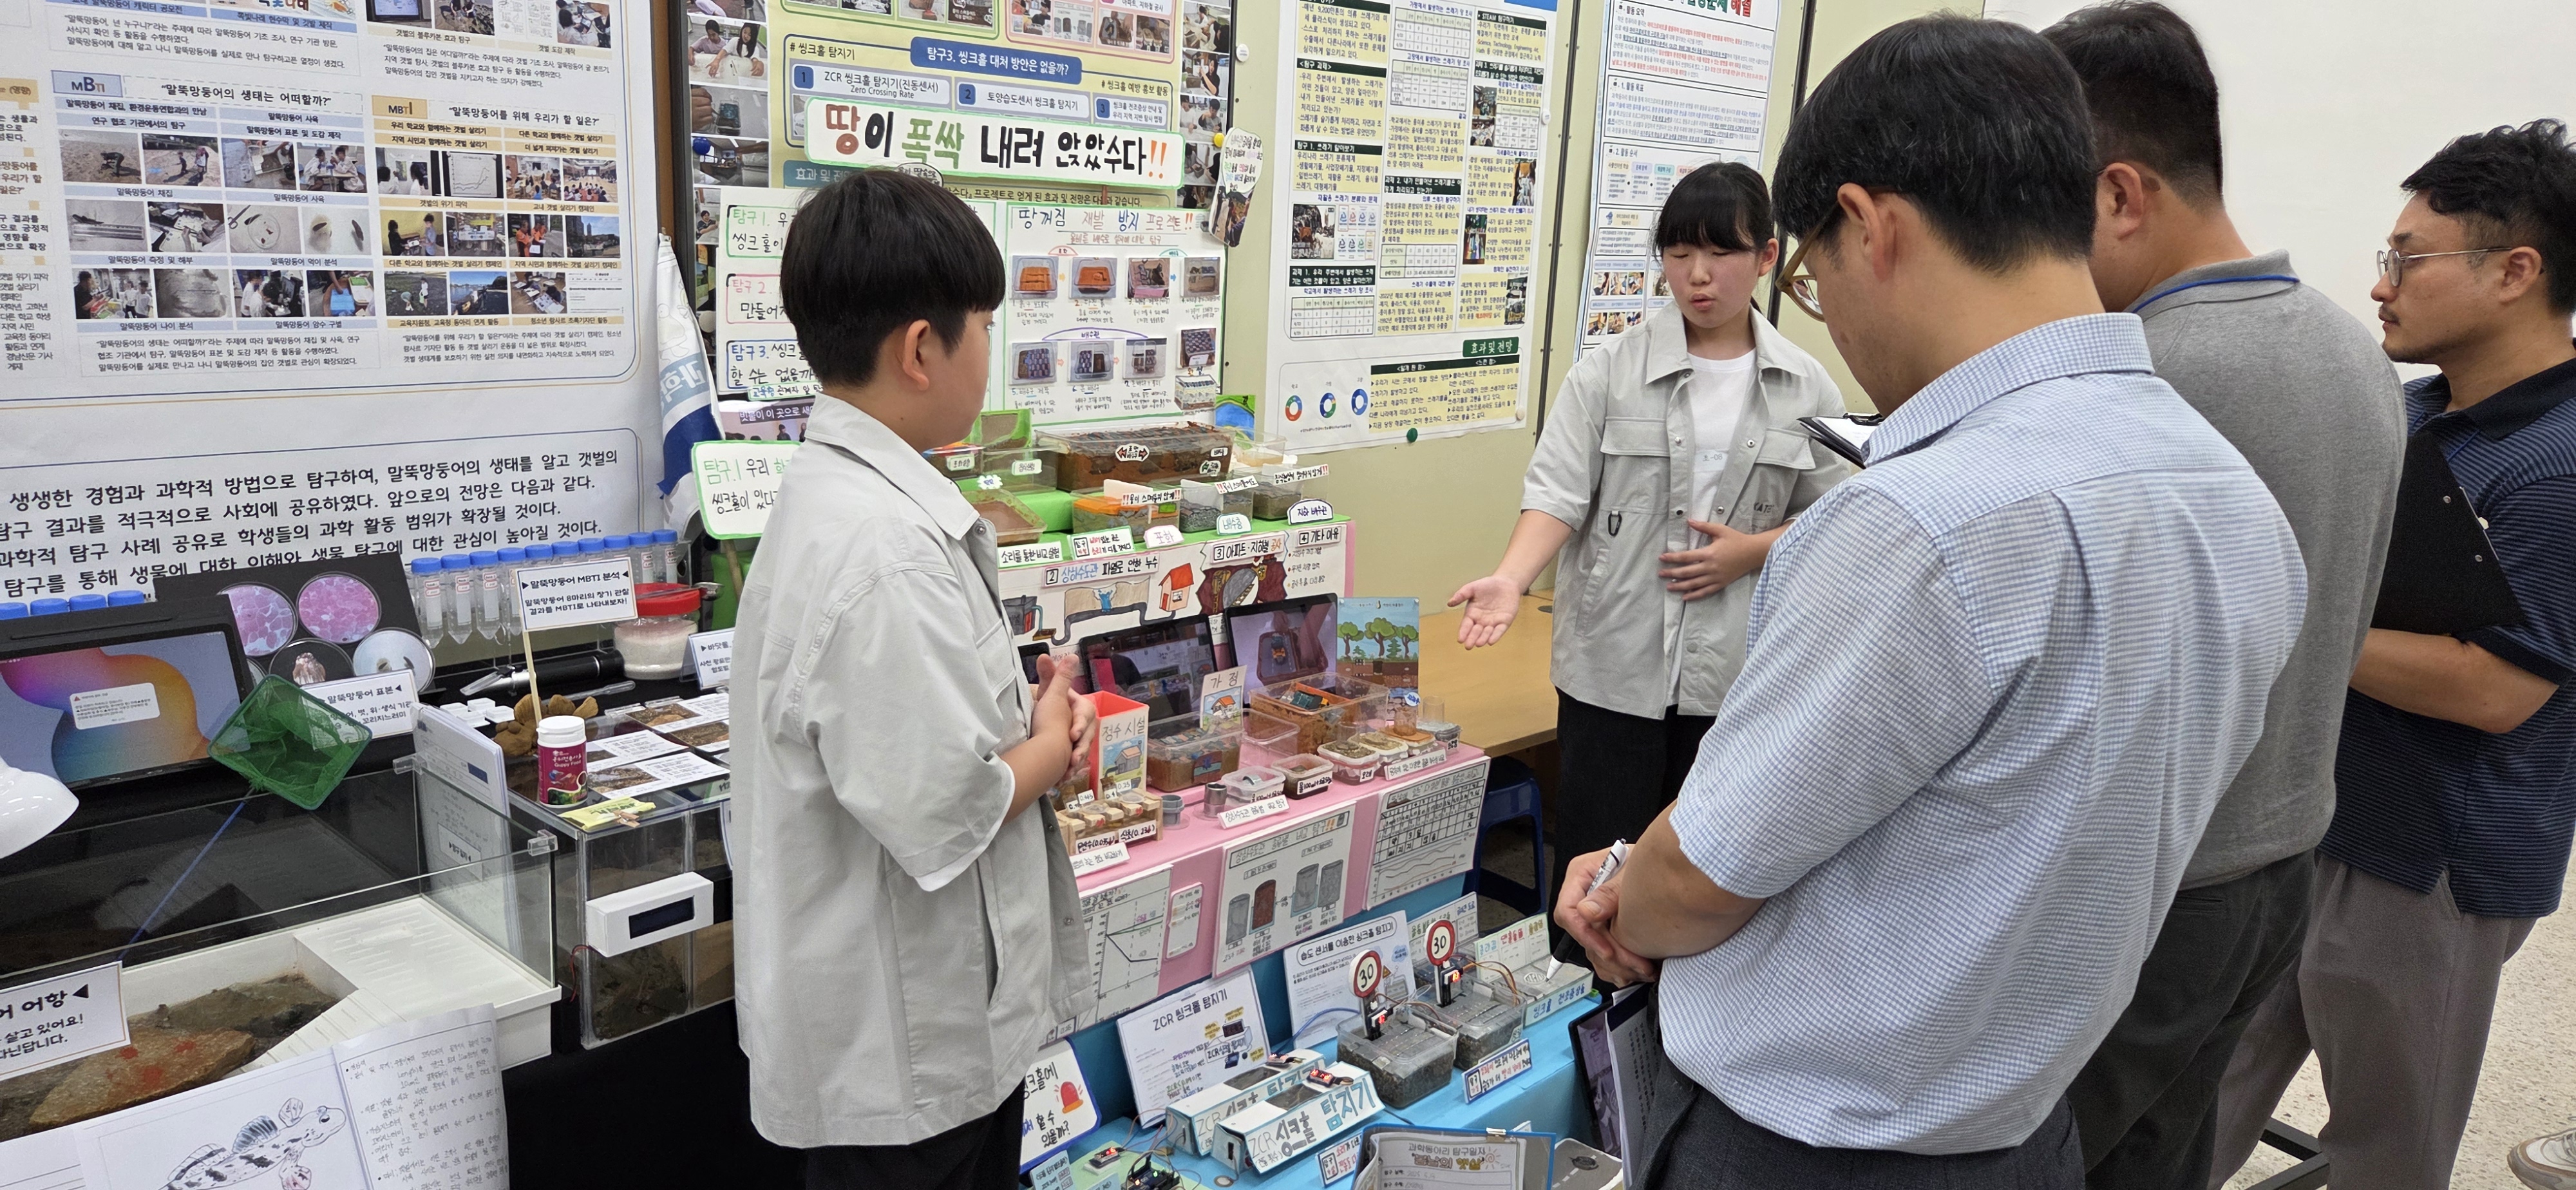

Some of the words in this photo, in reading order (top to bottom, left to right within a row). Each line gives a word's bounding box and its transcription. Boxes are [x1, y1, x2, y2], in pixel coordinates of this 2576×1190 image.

[790, 42, 795, 52] #
[799, 42, 826, 57] 씽크홀
[829, 46, 855, 61] 탐지기
[927, 46, 956, 62] 탐구3.
[958, 50, 987, 67] 씽크홀
[990, 55, 1009, 69] 대처
[1011, 59, 1037, 72] 방안은
[1040, 61, 1069, 75] 없을까?
[71, 77, 105, 93] MBTI
[801, 71, 806, 82] 1
[824, 71, 842, 82] ZCR
[844, 73, 870, 85] 씽크홀
[873, 76, 939, 93] 탐지기(진동센서)
[241, 90, 274, 102] 생태는
[851, 85, 867, 93] Zero
[868, 87, 897, 98] Crossing
[965, 89, 971, 99] 2
[1107, 80, 1126, 91] 씽크홀
[1128, 84, 1141, 93] 예방
[388, 101, 413, 115] MBTI
[987, 92, 1032, 107] 토양습도센서
[1035, 97, 1056, 109] 씽크홀
[1058, 100, 1078, 111] 탐지기
[1100, 104, 1106, 113] 3
[512, 110, 530, 122] 위해
[534, 113, 559, 124] 우리가
[564, 115, 571, 124] 할
[826, 104, 894, 157] 땅이
[902, 118, 965, 169] 폭싹
[981, 125, 1044, 169] 내려
[1056, 131, 1167, 179] 앉았수다!!
[974, 188, 1015, 200] 프로젝트로
[1017, 191, 1032, 201] 얻게
[1035, 192, 1042, 202] 된
[1043, 193, 1059, 203] 효과
[1061, 194, 1067, 203] 및
[1069, 195, 1091, 205] 전망은
[1113, 196, 1142, 207] 같습니다.
[1082, 210, 1104, 231] 재발
[1118, 209, 1139, 232] 방지
[10, 489, 73, 511] 생생한
[86, 485, 145, 505] 경험과
[156, 479, 213, 498] 과학적
[225, 475, 296, 495] 방법으로
[307, 468, 379, 489] 탐구하여,
[388, 460, 480, 482] 말뚝망둥어의
[489, 456, 533, 475] 생태를
[542, 454, 570, 471] 알고
[578, 450, 618, 468] 갯벌의
[46, 515, 106, 538] 결과를
[118, 507, 212, 530] 적극적으로
[223, 501, 278, 520] 사회에
[289, 494, 379, 516] 공유하였다.
[388, 487, 450, 507] 앞으로의
[459, 482, 503, 501] 전망은
[511, 478, 554, 495] 다음과
[563, 475, 595, 491] 같다.
[0, 547, 56, 567] 과학적
[70, 543, 109, 563] 탐구
[121, 538, 160, 556] 사례
[173, 533, 227, 554] 공유로
[238, 524, 309, 546] 학생들의
[319, 520, 354, 537] 과학
[364, 517, 396, 534] 활동
[406, 511, 452, 530] 범위가
[461, 505, 506, 524] 확장될
[515, 501, 561, 519] 것이다.
[5, 574, 66, 598] 탐구를
[79, 569, 118, 590] 통해
[412, 535, 444, 553] 대한
[453, 530, 497, 549] 관심이
[506, 525, 549, 544] 높아질
[558, 520, 601, 538] 것이다.
[530, 576, 575, 589] 말뚝망둥어
[577, 574, 600, 583] MBTI
[603, 571, 620, 580] 분석
[566, 592, 594, 601] 8마리의
[555, 603, 584, 612] MBTI로
[376, 686, 393, 695] 표본
[1102, 725, 1122, 741] 정수
[1124, 717, 1145, 735] 시설
[1434, 935, 1446, 954] 30
[1359, 963, 1374, 988] 30
[22, 990, 68, 1011] 어항
[1153, 1013, 1174, 1031] ZCR
[1175, 1000, 1201, 1021] 씽크홀
[1203, 988, 1227, 1010] 탐지기
[5, 1028, 33, 1044] 살고
[37, 1013, 83, 1035] 있어요!
[1248, 1131, 1275, 1158] ZCR
[1320, 1077, 1376, 1132] 탐지기
